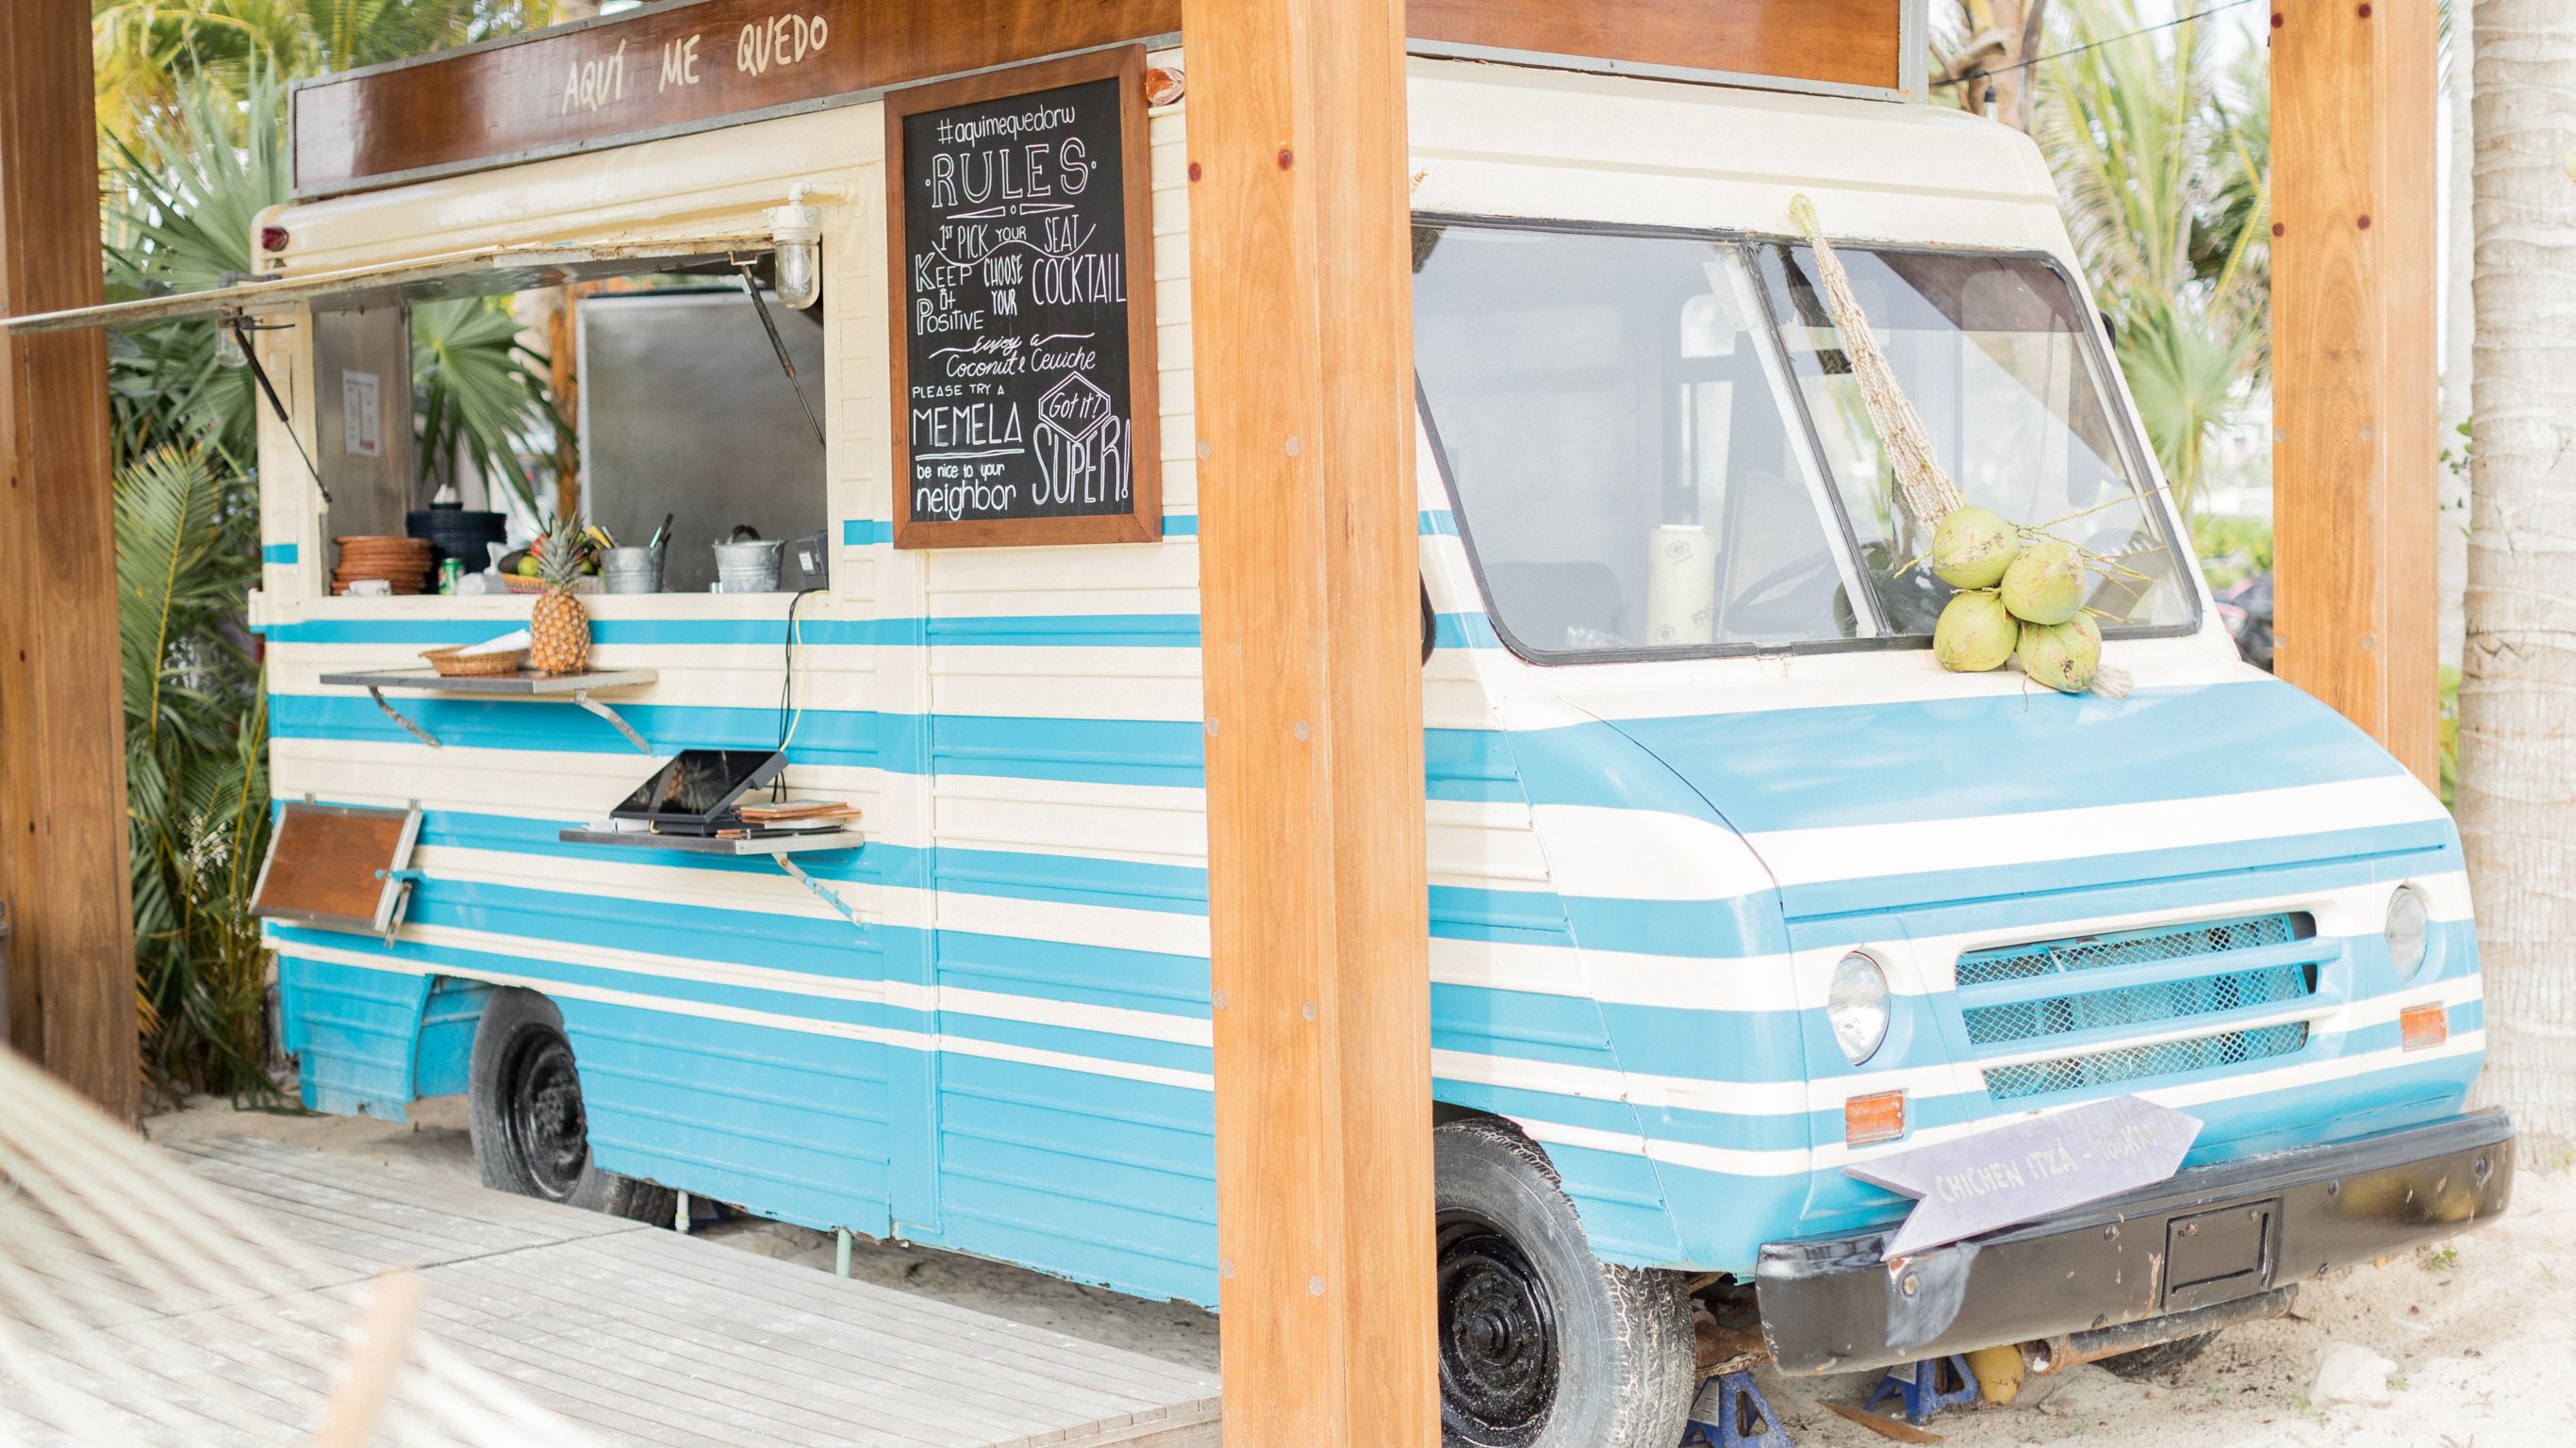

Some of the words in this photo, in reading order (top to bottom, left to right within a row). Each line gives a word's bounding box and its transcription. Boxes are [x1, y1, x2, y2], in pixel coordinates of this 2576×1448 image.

[562, 38, 626, 115] AQUÍ
[659, 34, 701, 92] ME
[737, 14, 828, 76] QUEDO
[936, 105, 1075, 147] #aquimequedorw
[932, 137, 1089, 207] RULES
[957, 223, 989, 259] PICK
[995, 225, 1027, 242] YOUR
[1045, 214, 1080, 253] SEAT
[915, 252, 972, 292] KEEP
[983, 253, 1024, 288] CHOOSE
[1032, 253, 1127, 305] COCKTAIL
[990, 288, 1018, 317] YOUR
[946, 349, 1018, 378] Coconut
[1031, 346, 1097, 371] Ceviche
[972, 335, 1022, 356] Enjoy
[912, 385, 964, 399] PLEASE
[969, 383, 992, 396] TRY
[997, 385, 1005, 396] A
[1049, 392, 1080, 420] Got
[913, 401, 1023, 448] MEMELA
[916, 464, 933, 480] be
[936, 463, 959, 479] nice
[963, 464, 974, 478] to
[981, 463, 1006, 483] your
[1032, 415, 1131, 505] SUPER!
[916, 478, 1016, 521] neighbor
[1934, 1158, 2024, 1205] CHICHEN
[2024, 1136, 2081, 1180] ITZÁ
